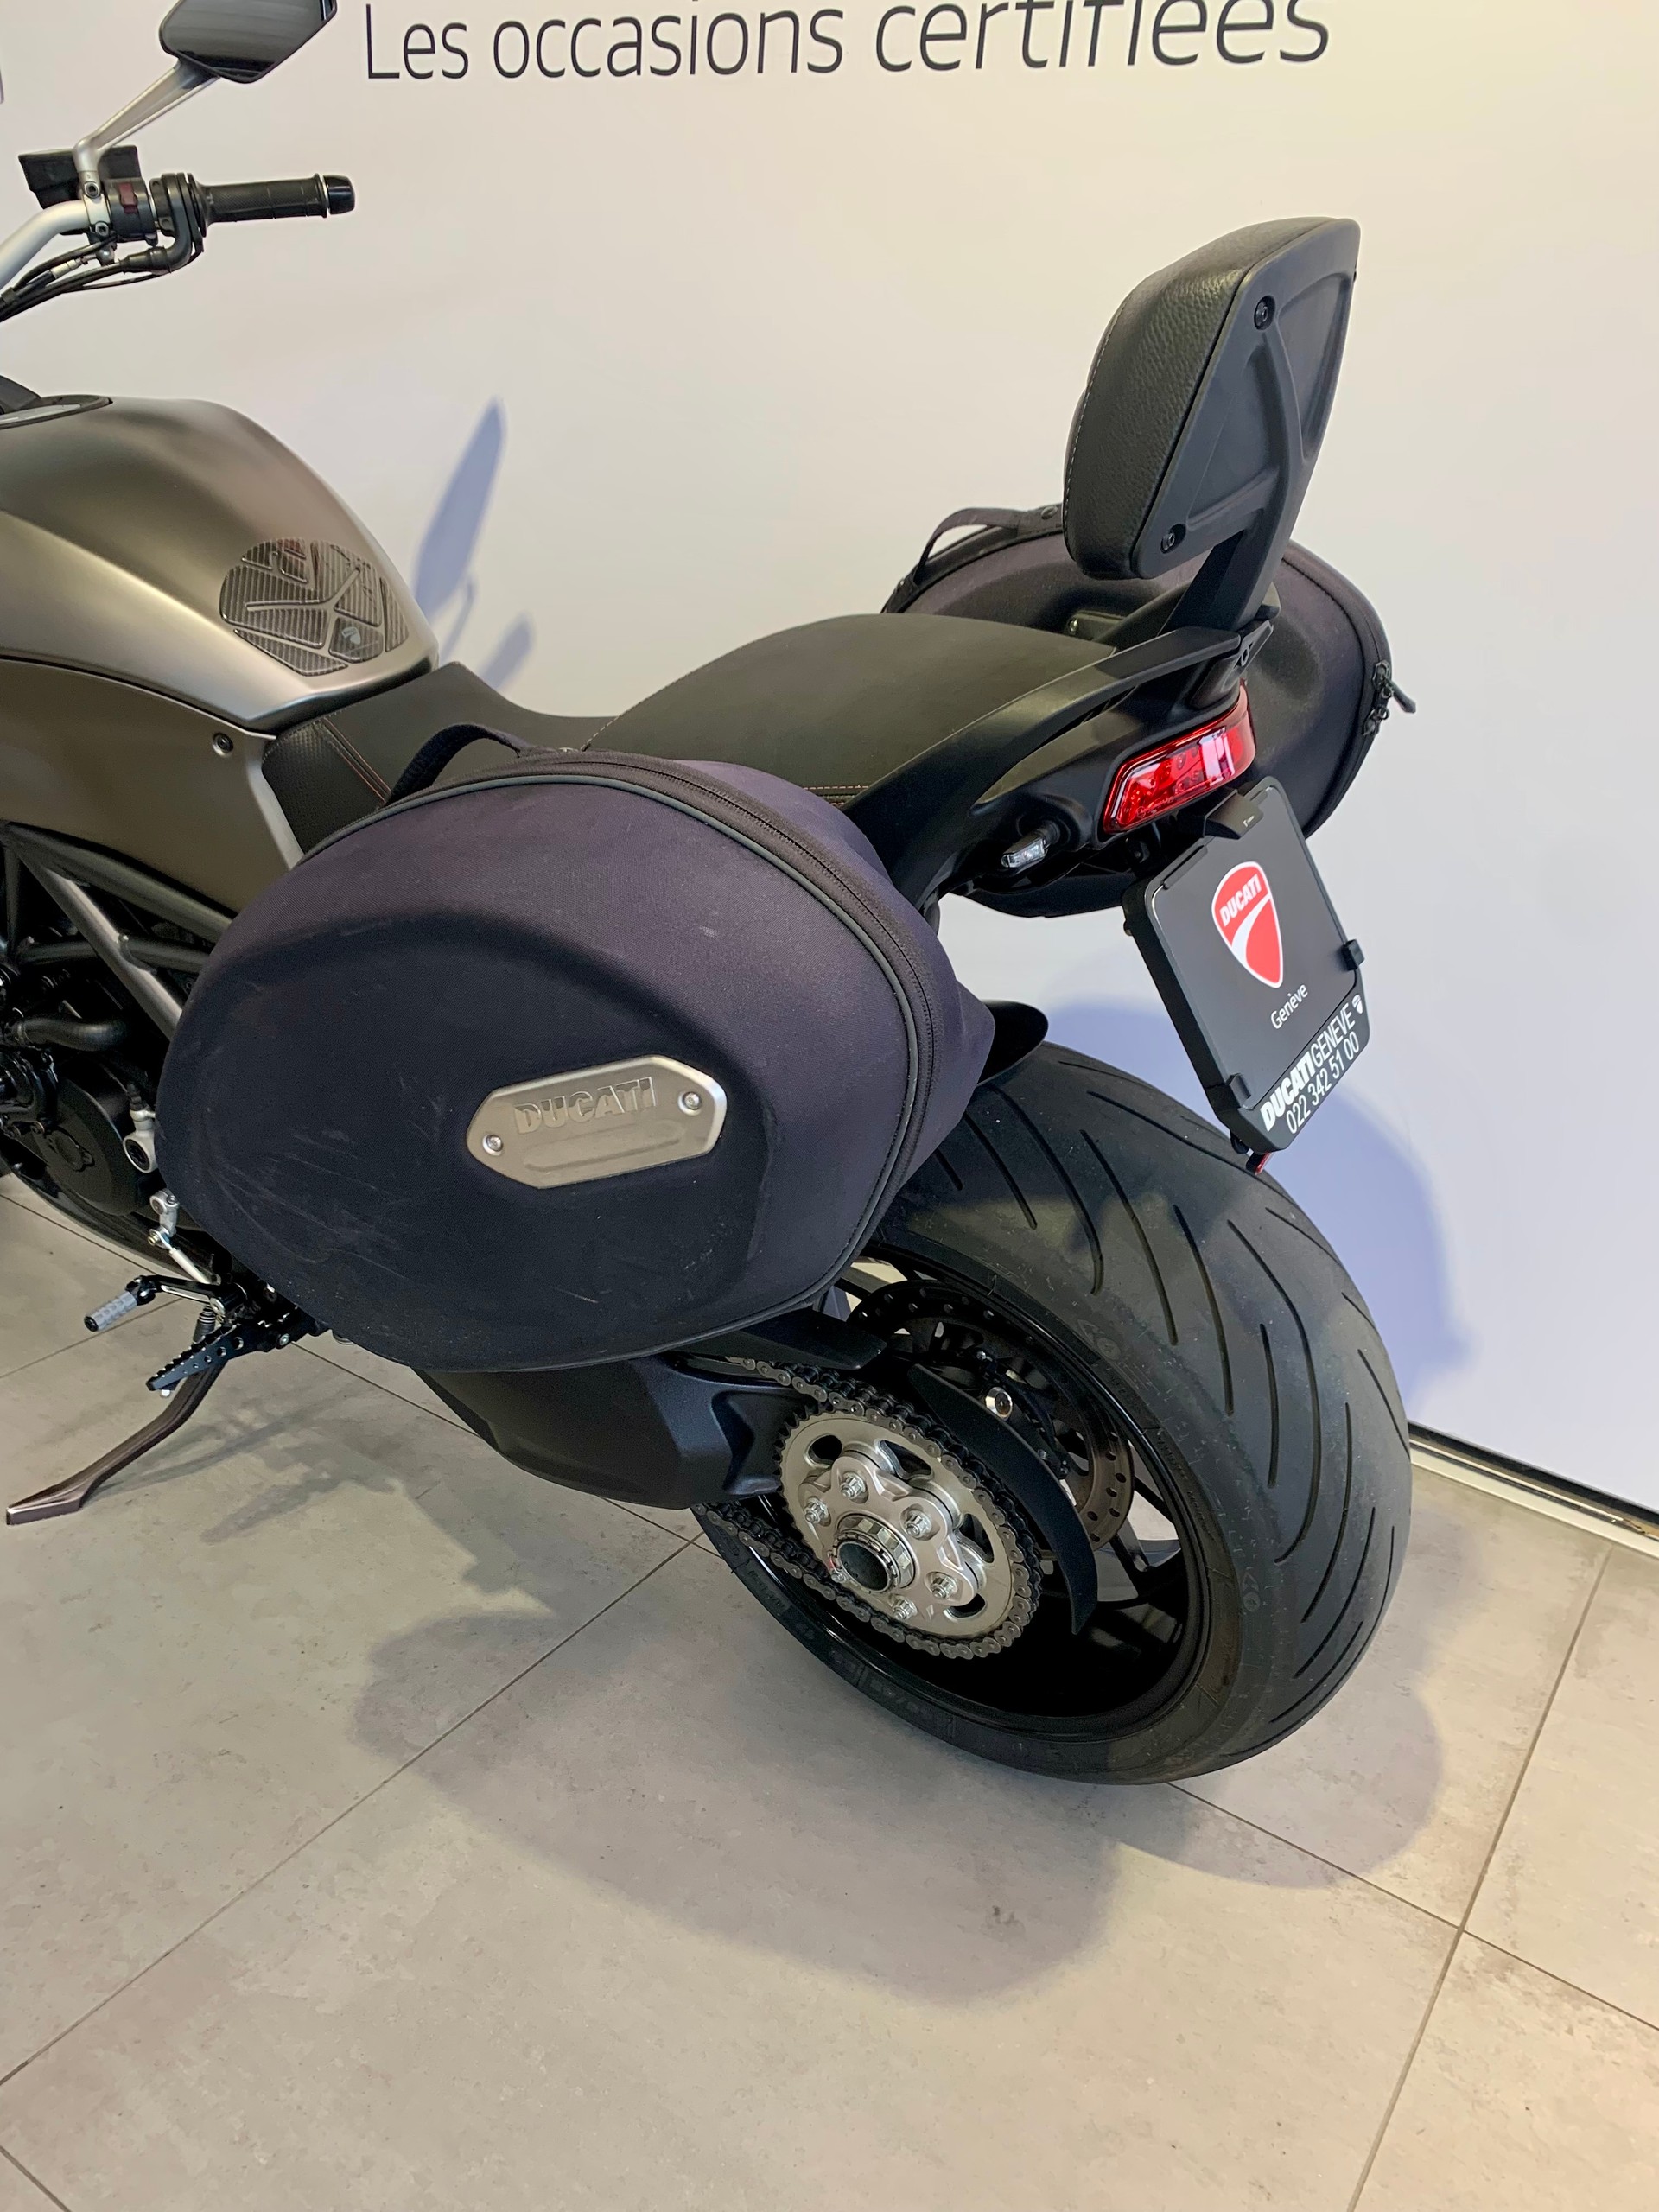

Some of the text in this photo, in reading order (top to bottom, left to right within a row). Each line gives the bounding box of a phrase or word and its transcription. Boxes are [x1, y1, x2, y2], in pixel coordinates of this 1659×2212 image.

[365, 3, 469, 80] Les
[493, 9, 843, 79] occasions
[1219, 874, 1262, 927] DUCATI
[1270, 983, 1308, 1029] Genève
[513, 1076, 657, 1135] DUCATI
[1286, 1094, 1311, 1134] 022
[1307, 1067, 1332, 1106] 342
[1328, 1048, 1345, 1079] 51
[1343, 1031, 1360, 1061] 00
